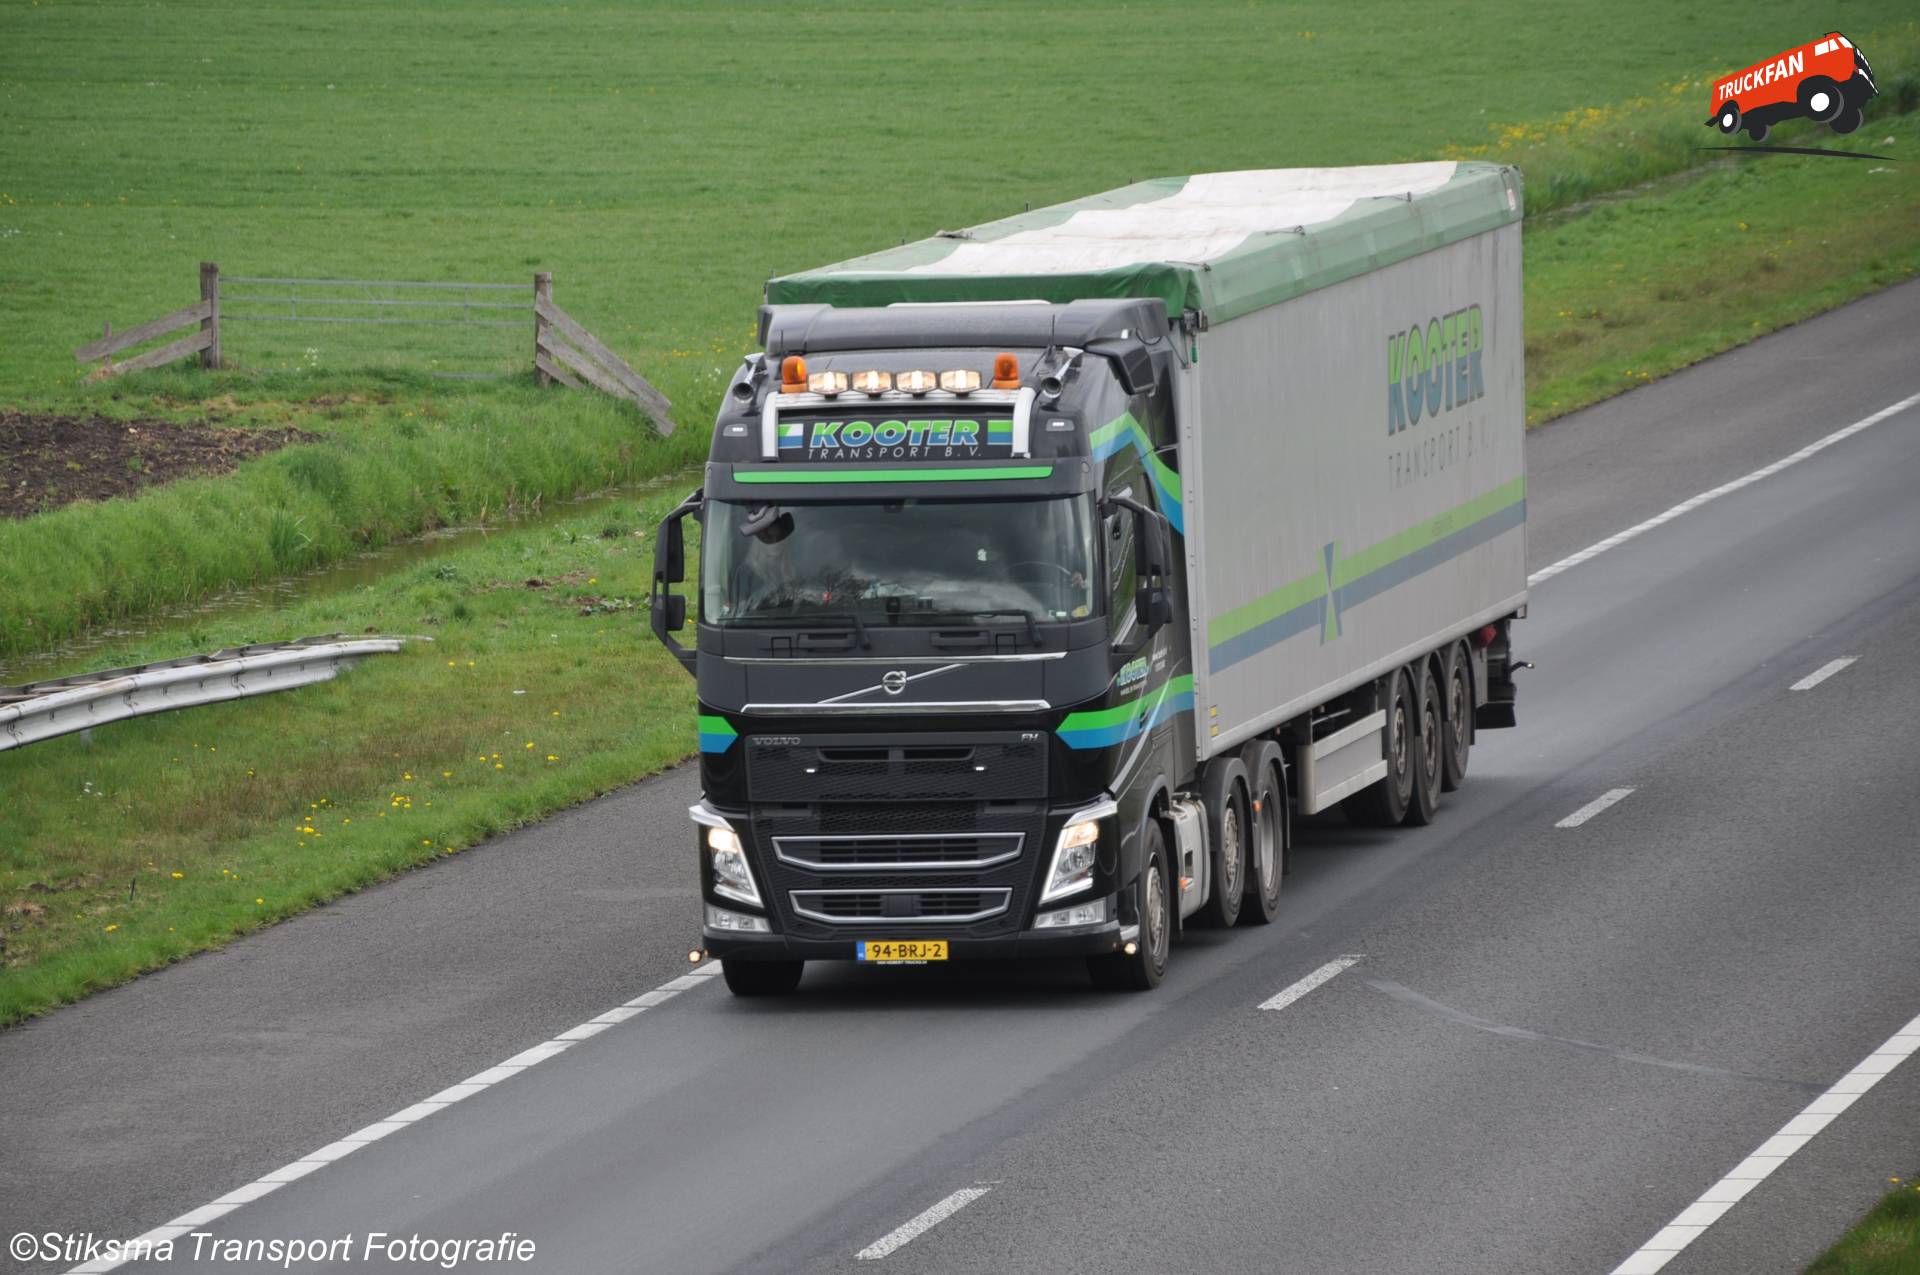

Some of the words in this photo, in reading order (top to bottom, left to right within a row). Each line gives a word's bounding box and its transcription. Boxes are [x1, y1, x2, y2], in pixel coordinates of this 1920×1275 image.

[1387, 303, 1485, 437] KOOTER
[810, 419, 980, 449] KOOTER
[808, 446, 931, 460] TRANSPORT
[752, 737, 801, 746] VOLVO
[1021, 732, 1039, 742] FH
[872, 943, 942, 958] 94-BRJ-2
